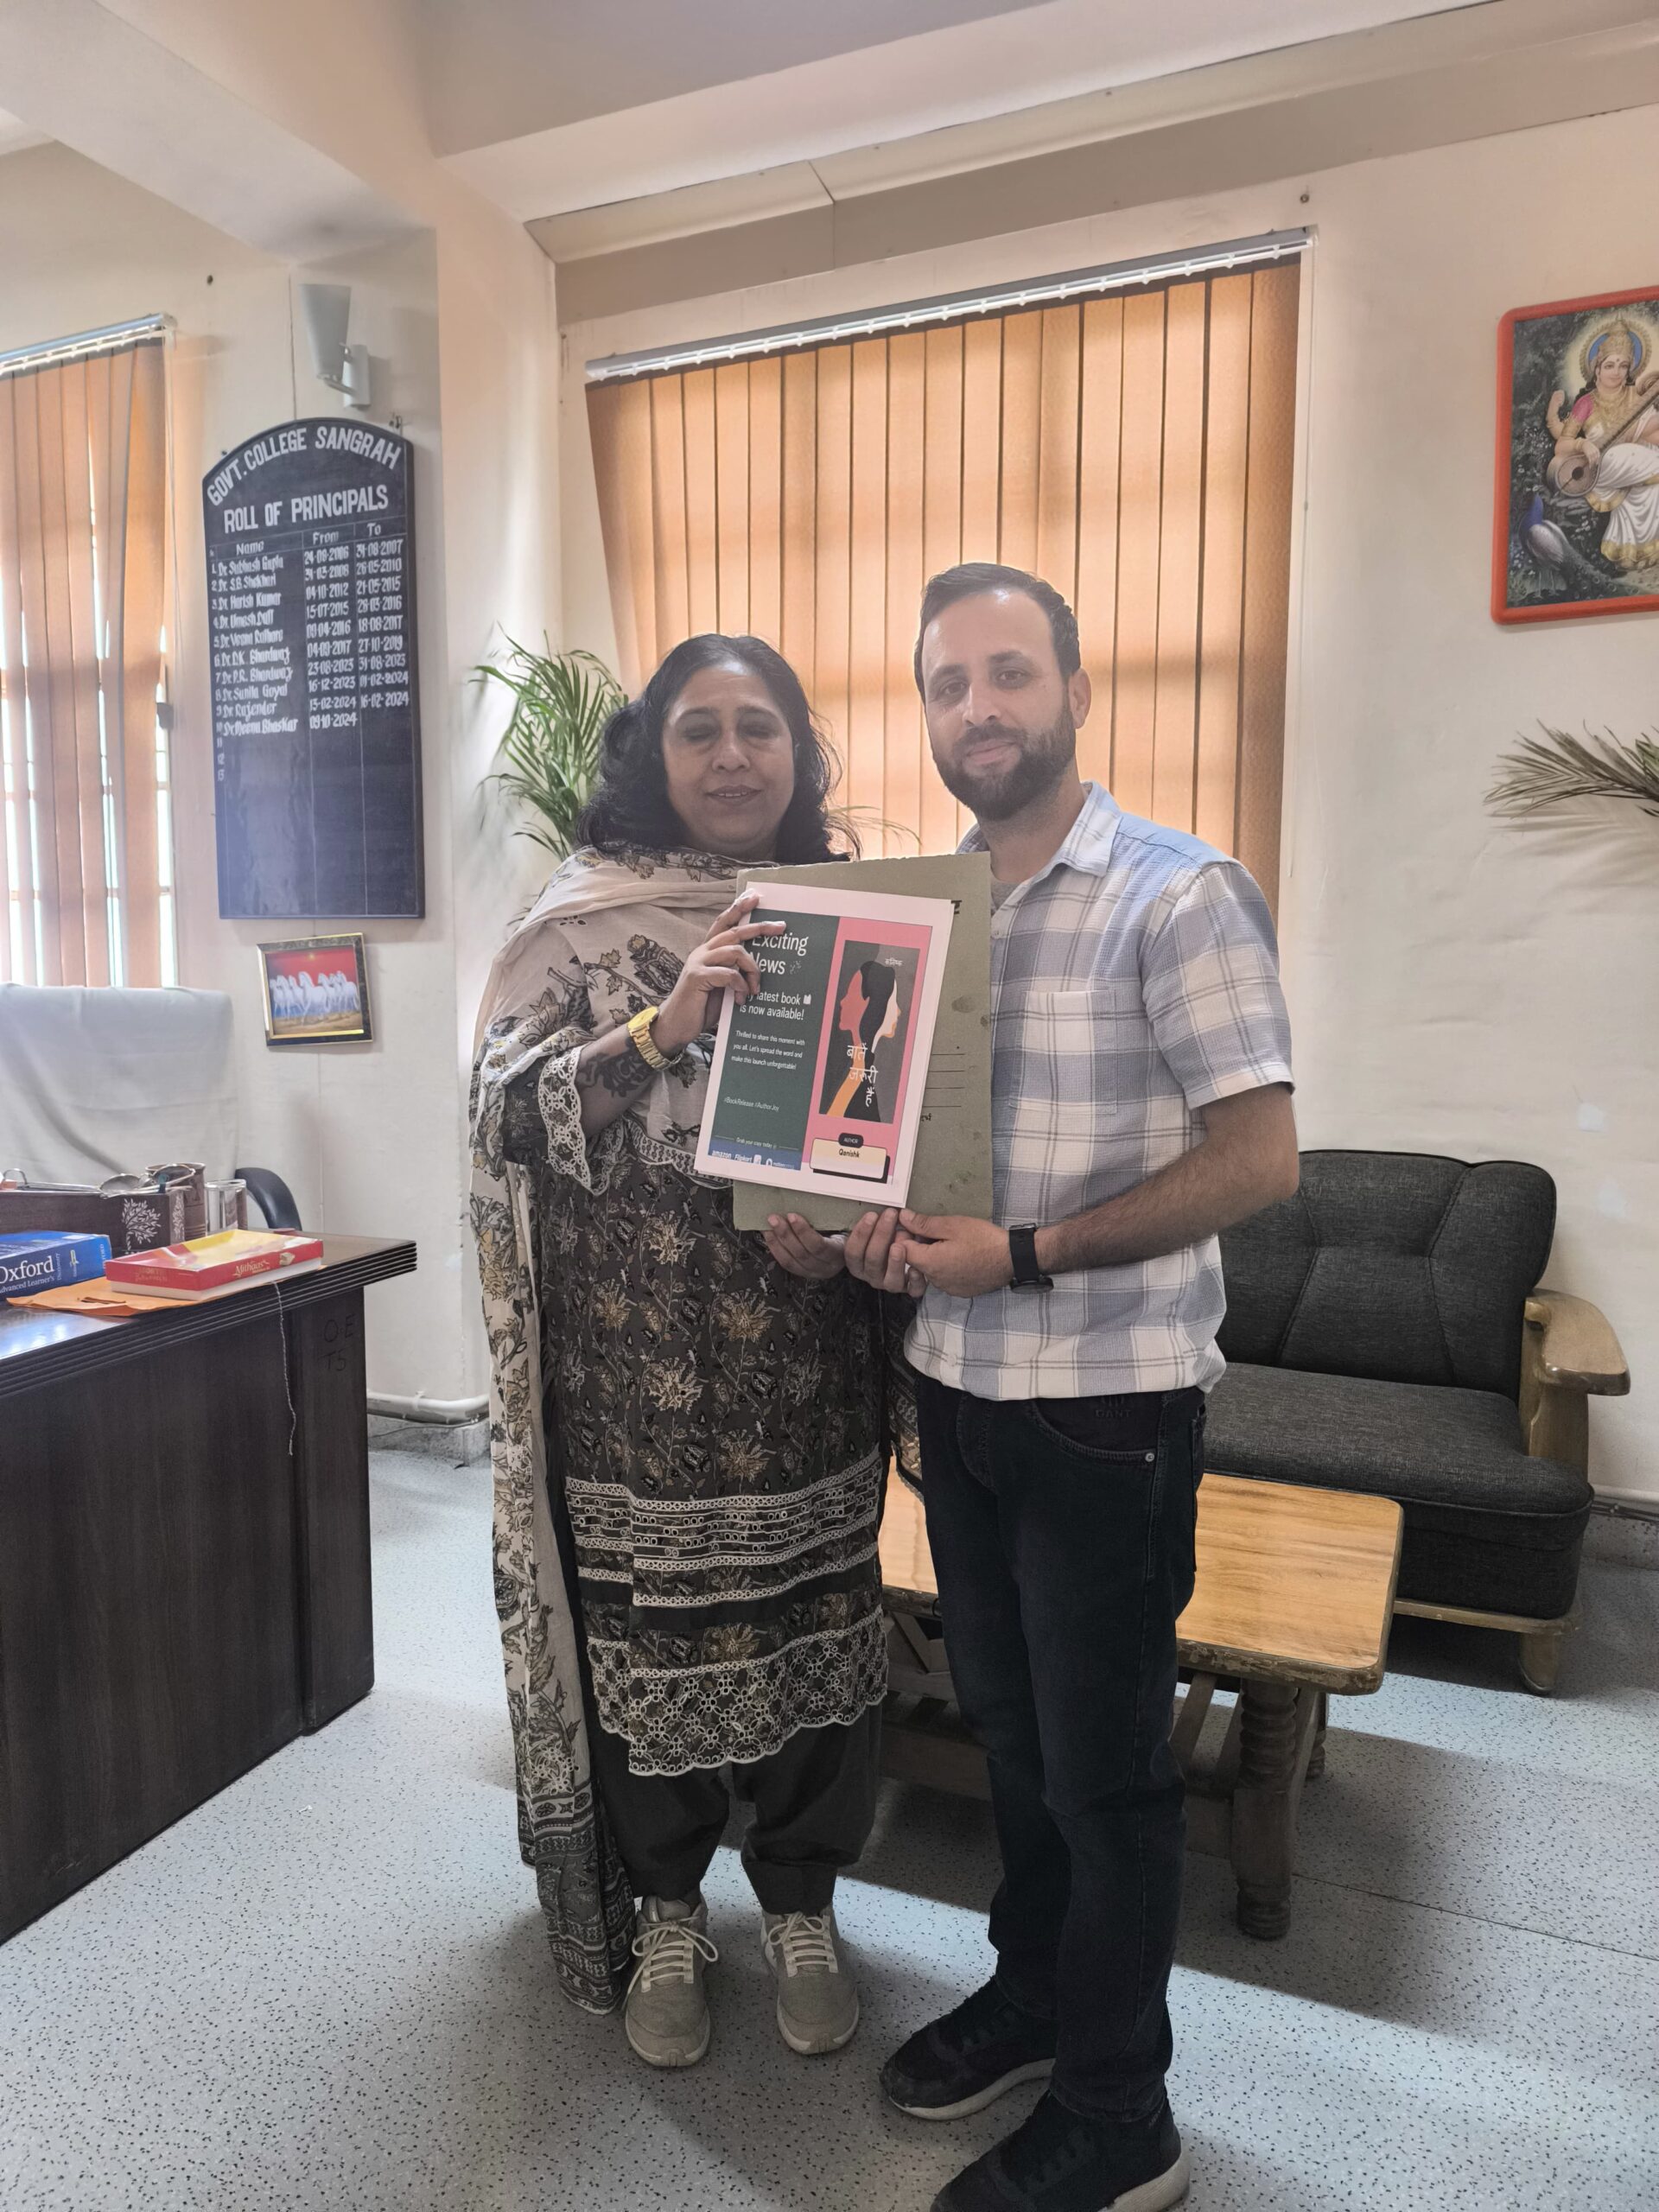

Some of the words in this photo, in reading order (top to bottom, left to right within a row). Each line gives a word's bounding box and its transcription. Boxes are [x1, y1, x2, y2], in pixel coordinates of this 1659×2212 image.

[244, 428, 307, 471] COLLEGE
[315, 426, 401, 469] SANGRAH
[224, 506, 258, 533] ROLL
[264, 501, 283, 526] OF
[291, 485, 389, 523] PRINCIPALS
[236, 541, 264, 556] Name
[312, 531, 339, 545] From
[366, 523, 381, 537] To
[262, 683, 288, 702] Goyal
[752, 932, 809, 957] Exciting
[781, 992, 801, 1005] book
[748, 1005, 766, 1015] now
[766, 1007, 805, 1020] available!
[838, 1148, 860, 1158] Qanishk
[0, 1282, 27, 1294] dvanced
